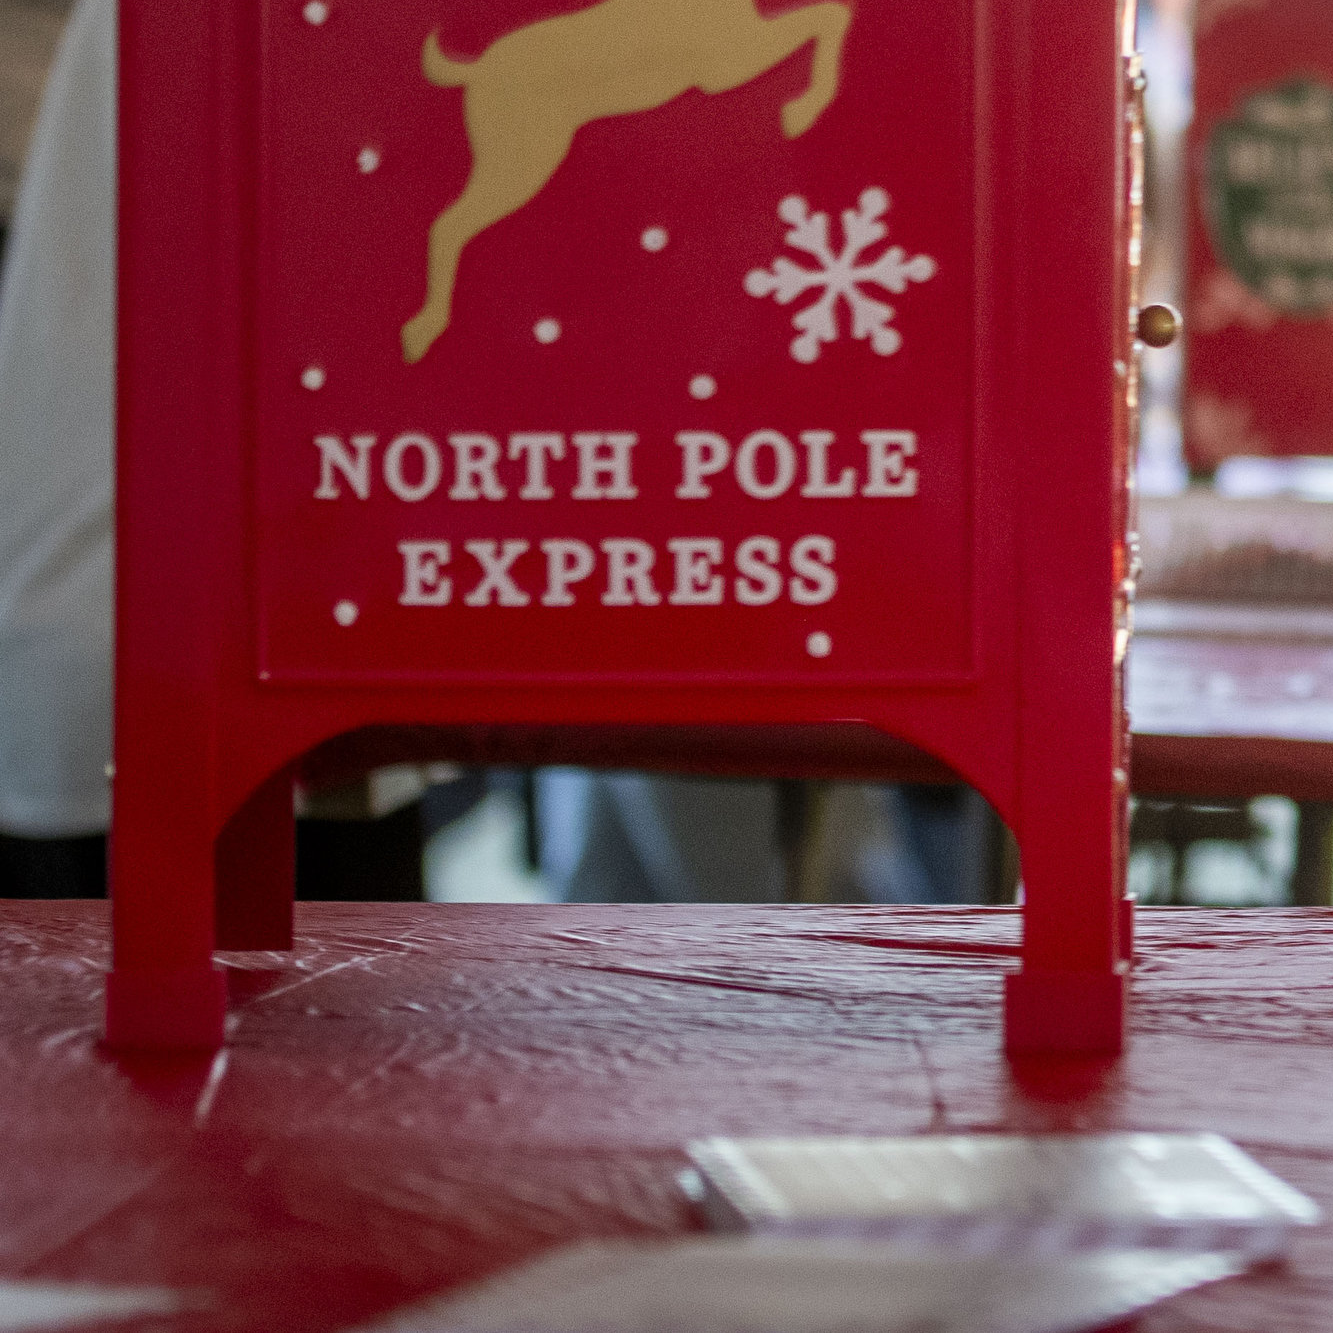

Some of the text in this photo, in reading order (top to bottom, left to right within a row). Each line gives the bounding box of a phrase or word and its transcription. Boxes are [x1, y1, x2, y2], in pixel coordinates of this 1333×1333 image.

[314, 430, 919, 502] NORTH POLE
[398, 535, 838, 607] EXPRESS
